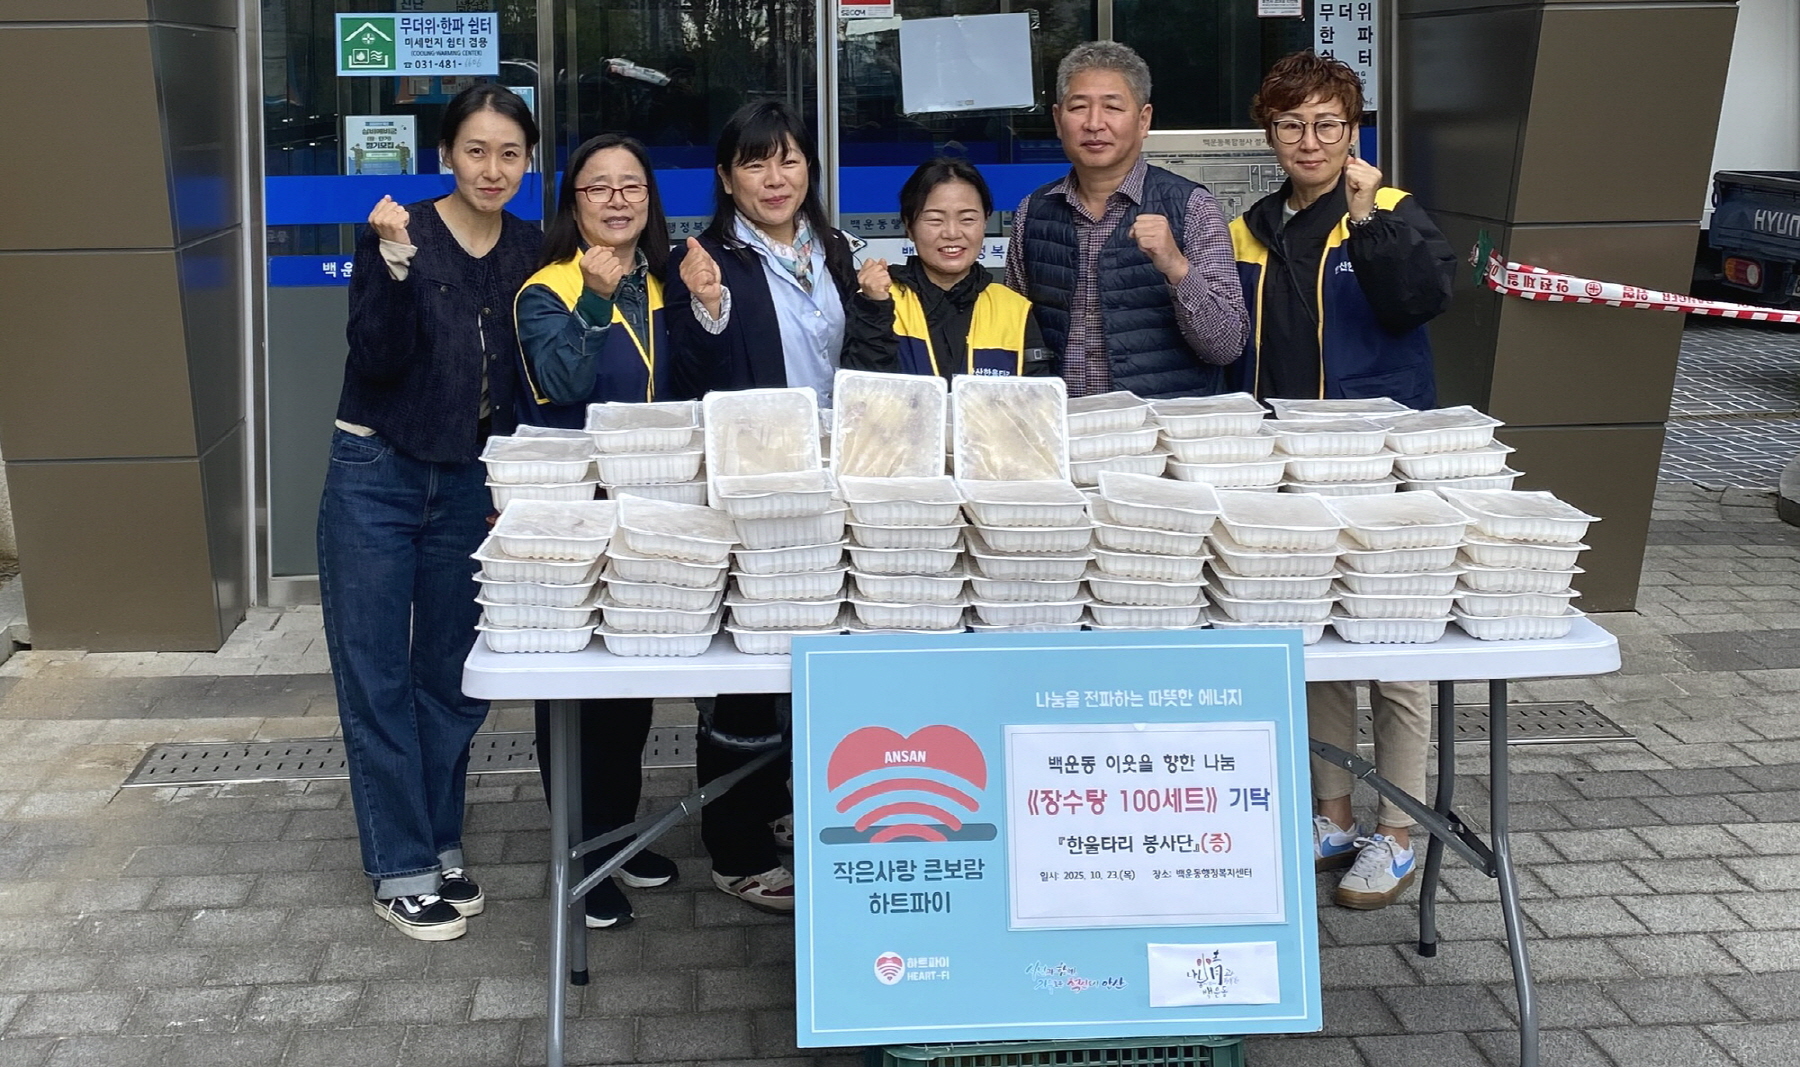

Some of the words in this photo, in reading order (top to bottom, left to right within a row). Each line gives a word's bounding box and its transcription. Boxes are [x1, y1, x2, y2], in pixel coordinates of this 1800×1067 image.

[468, 17, 491, 35] 쉼터
[404, 37, 443, 49] 미세먼지
[447, 37, 466, 49] 쉼터
[469, 36, 488, 49] 겸용
[1036, 691, 1080, 708] 나눔을
[1084, 690, 1144, 708] 전파하는
[1149, 689, 1194, 707] 따뜻한
[1199, 689, 1243, 706] 에너지
[884, 750, 927, 764] ANSAN
[1049, 755, 1096, 774] 백운동
[1106, 754, 1153, 773] 이웃을
[1163, 754, 1195, 773] 향한
[1204, 754, 1235, 771] 나눔
[1230, 787, 1271, 812] 기탁
[833, 860, 918, 884] 작은사랑
[924, 858, 986, 882] 큰보람
[1176, 868, 1253, 879] 백운동행정복지센터
[869, 891, 951, 915] 하트파이
[906, 956, 950, 969] 하트파이
[906, 970, 950, 981] HEART-FI
